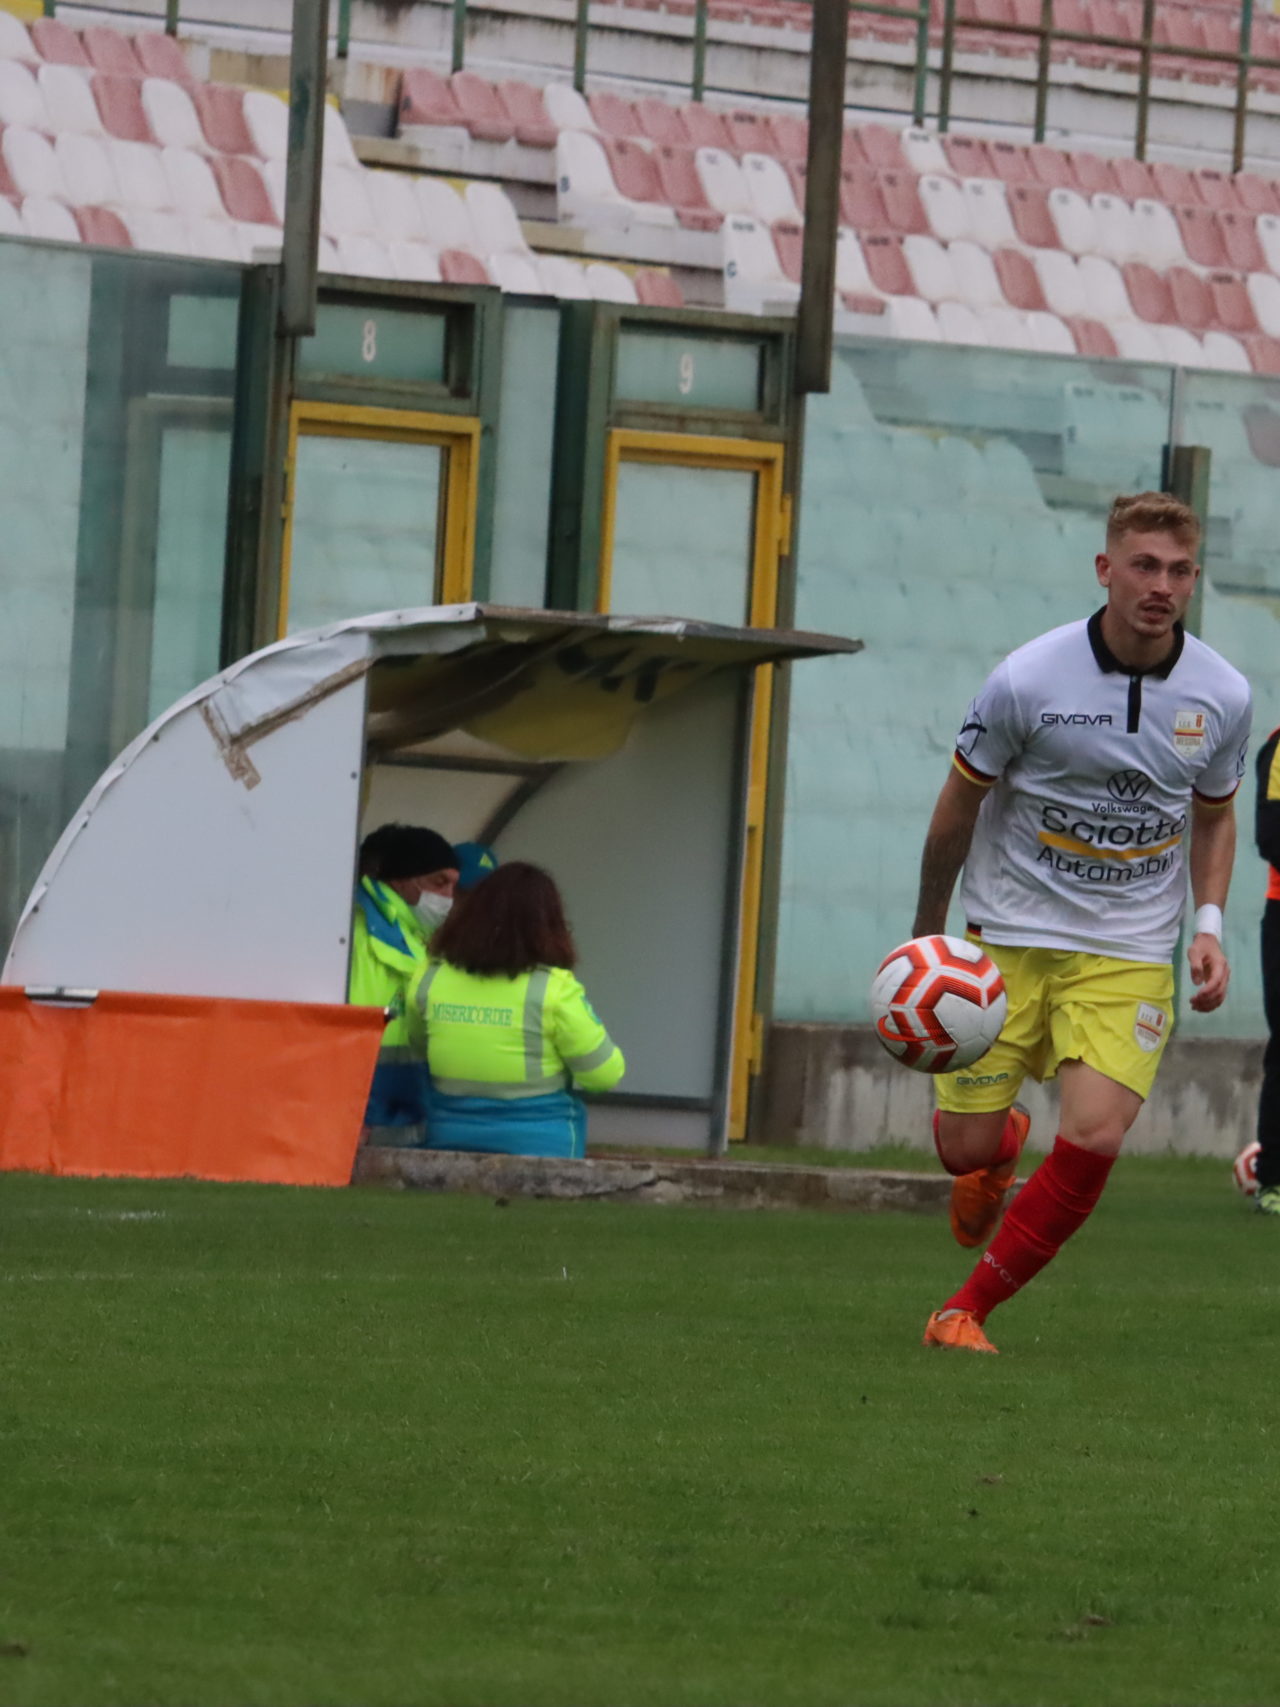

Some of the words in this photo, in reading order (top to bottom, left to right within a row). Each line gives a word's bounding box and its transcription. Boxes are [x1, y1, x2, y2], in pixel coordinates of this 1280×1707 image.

[362, 320, 377, 361] 8
[679, 353, 694, 394] 9
[1041, 713, 1112, 726] GIVOVA
[1041, 805, 1187, 847] Sciotto
[956, 1073, 1009, 1086] GIVOVA
